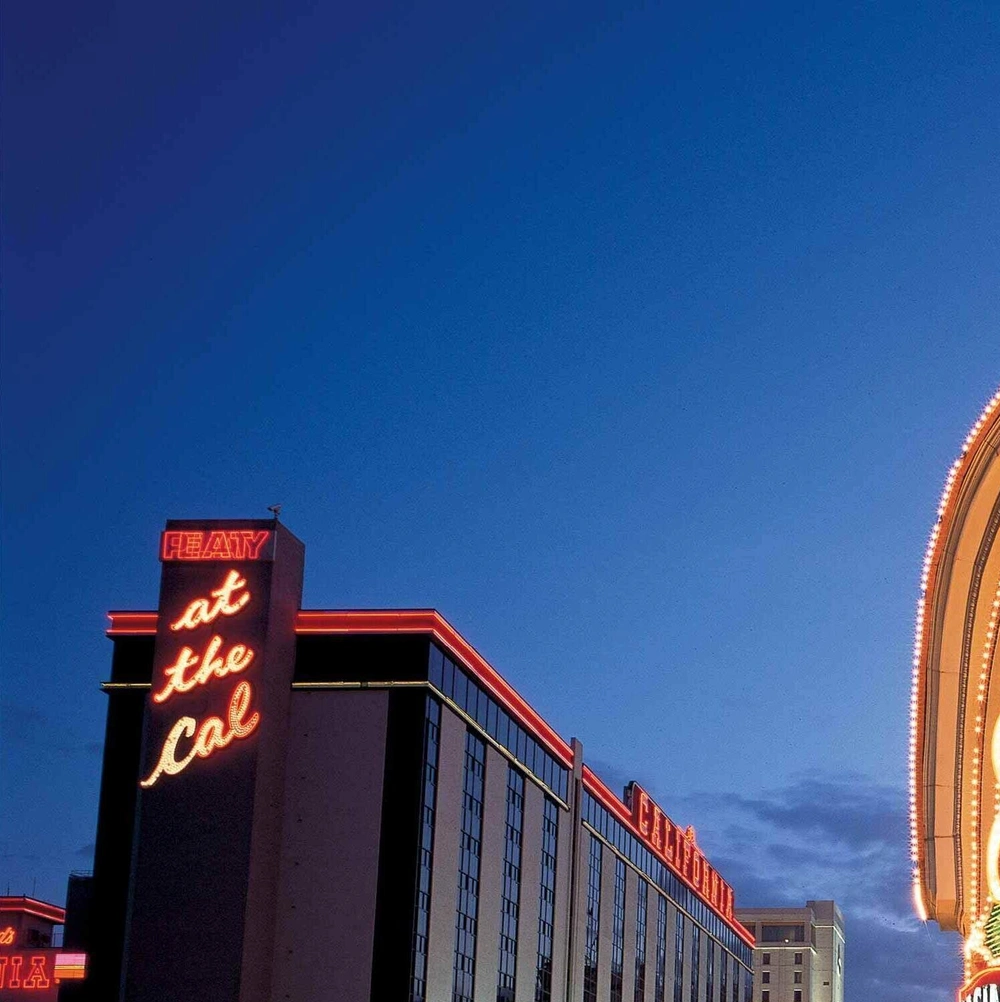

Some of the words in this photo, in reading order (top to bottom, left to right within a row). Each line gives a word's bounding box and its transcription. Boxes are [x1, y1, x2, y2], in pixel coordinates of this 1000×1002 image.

[170, 568, 250, 631] at
[154, 635, 254, 702] the
[140, 681, 260, 788] Cal
[639, 792, 734, 920] CALIFORNIA
